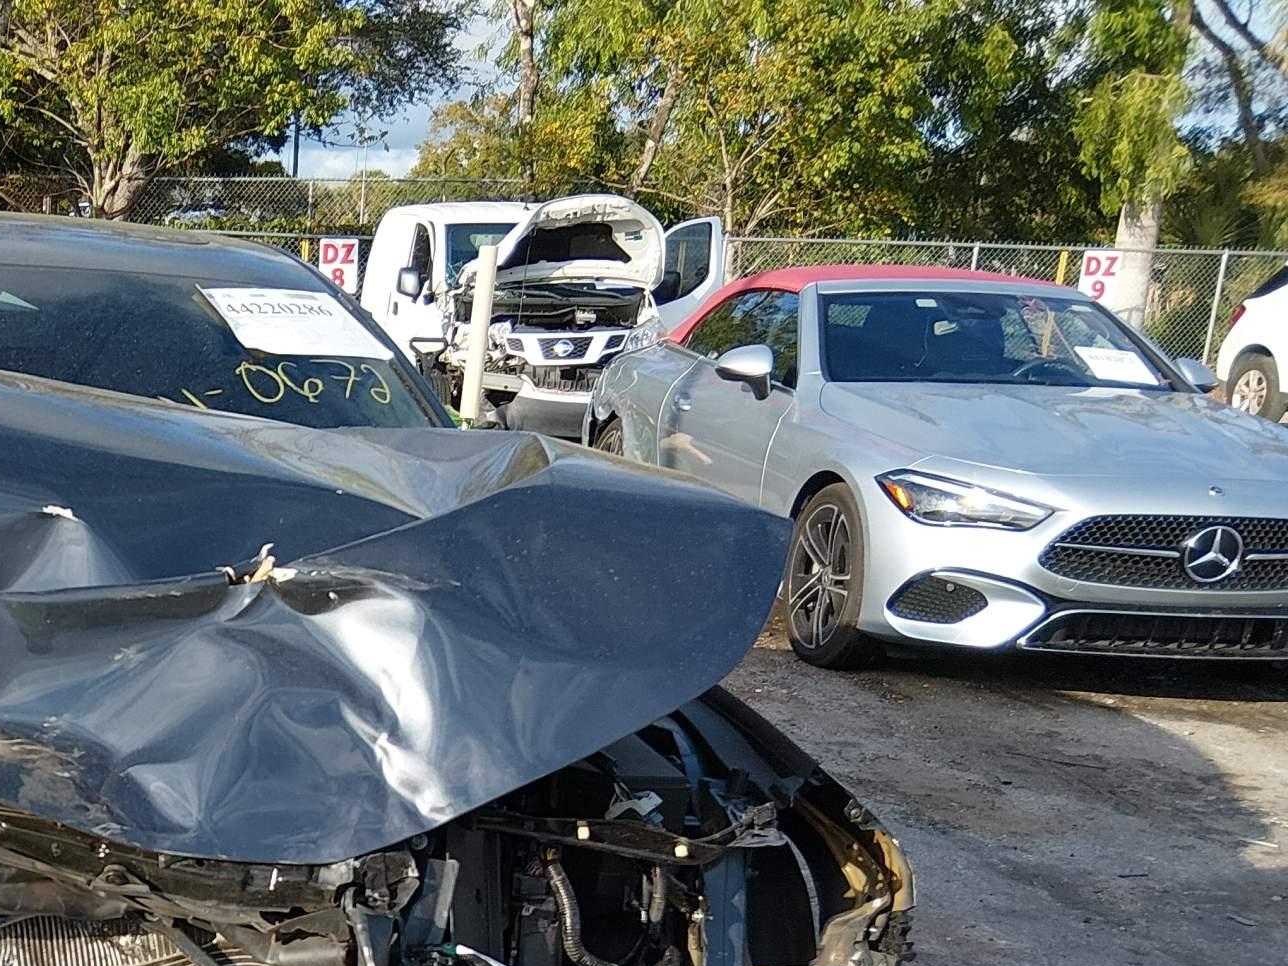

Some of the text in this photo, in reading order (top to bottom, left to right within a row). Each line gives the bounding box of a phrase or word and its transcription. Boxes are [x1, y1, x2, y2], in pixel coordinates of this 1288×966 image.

[322, 243, 356, 265] DZ
[1084, 256, 1120, 277] DZ
[331, 267, 345, 288] 8
[1091, 280, 1106, 301] 9
[226, 302, 334, 317] 44220286
